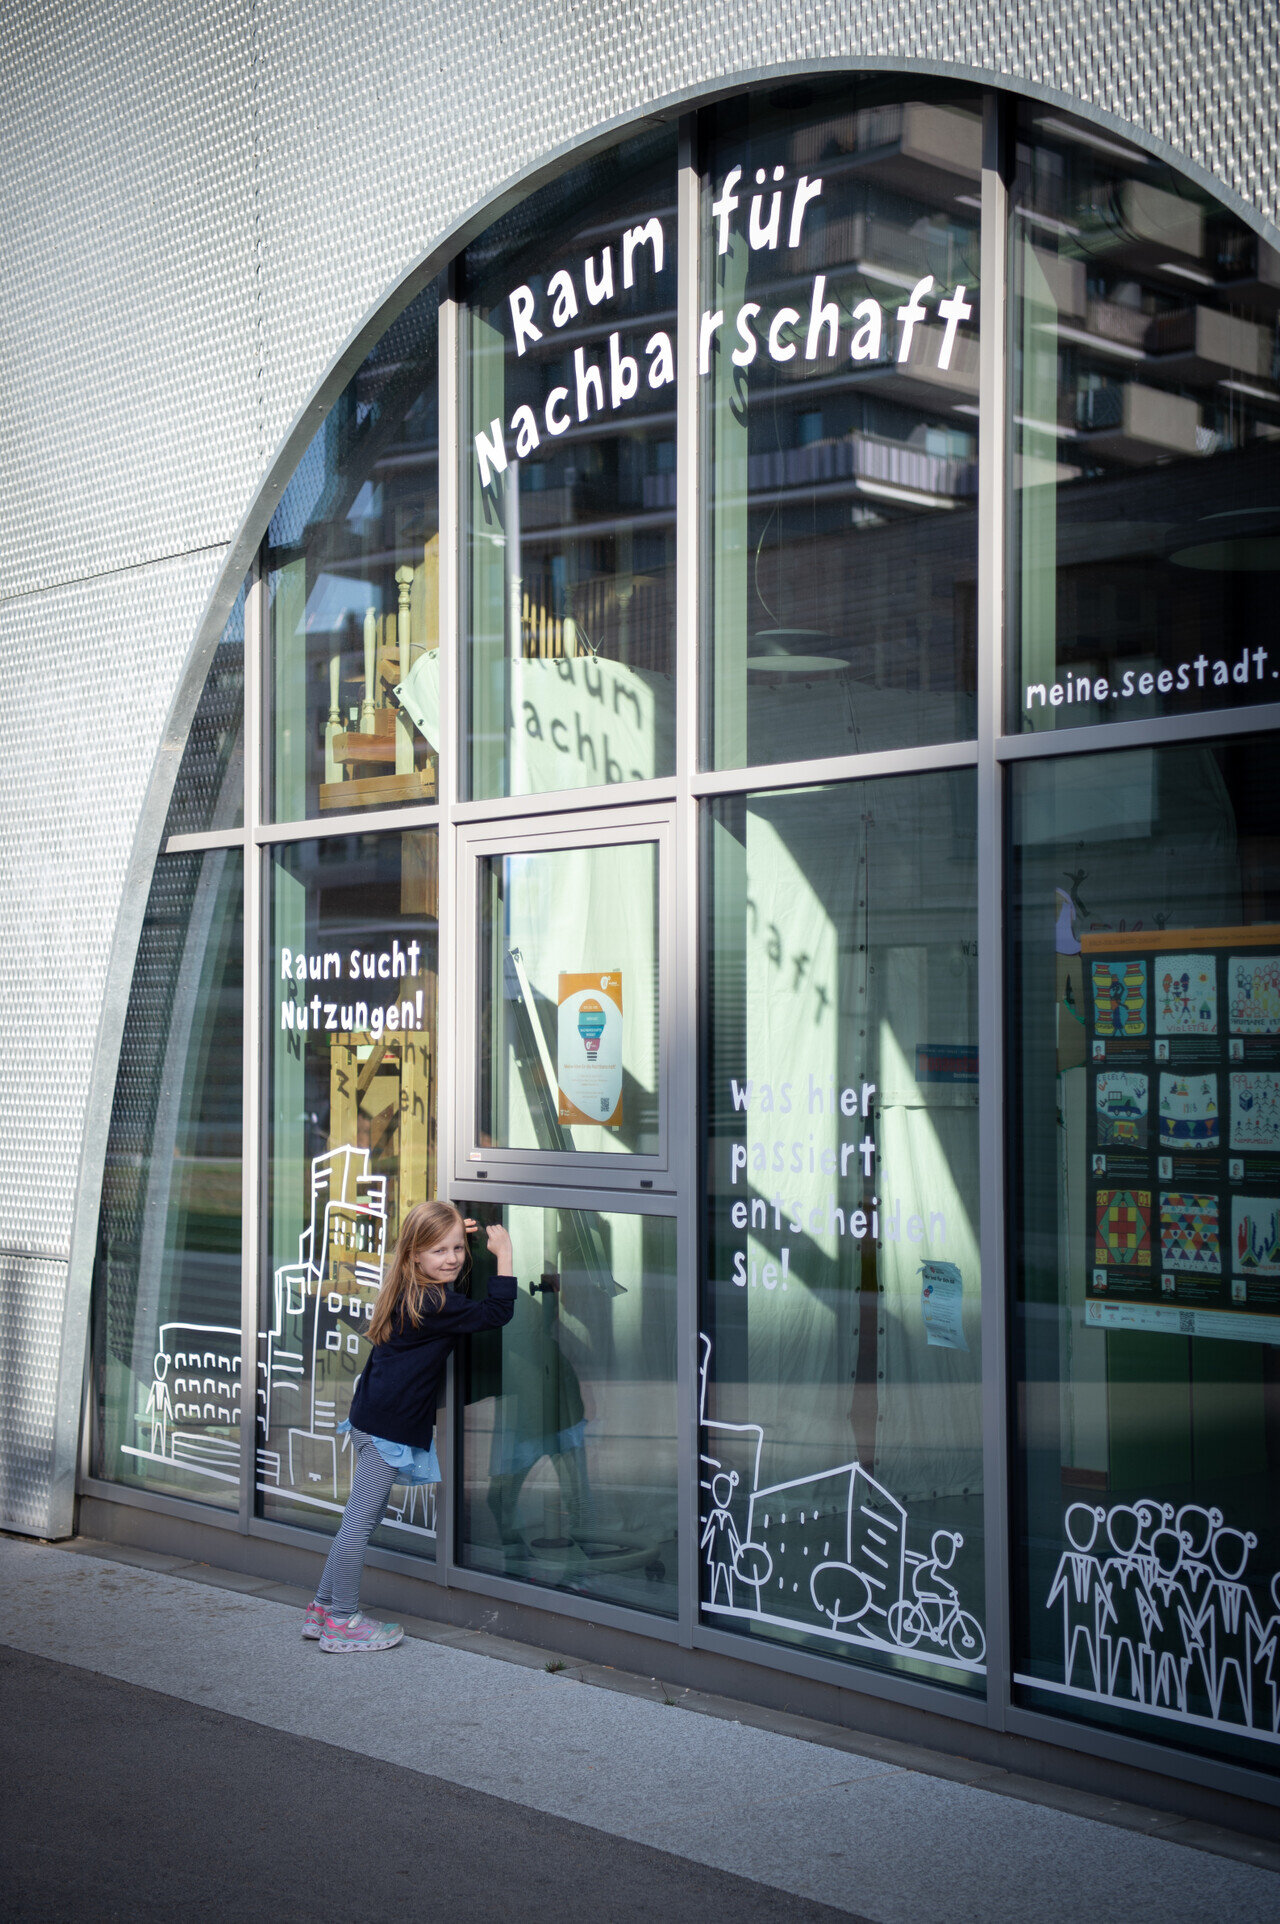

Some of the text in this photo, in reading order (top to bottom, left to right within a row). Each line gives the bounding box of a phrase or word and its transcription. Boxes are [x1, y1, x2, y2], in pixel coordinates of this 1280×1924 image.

[508, 163, 823, 357] Raum für
[474, 275, 972, 489] Nachbarschaft
[281, 940, 421, 980] Raum sucht
[281, 990, 424, 1040] Nutzungen!
[731, 1073, 876, 1117] was hier
[731, 1192, 947, 1244] entscheiden
[731, 1247, 790, 1292] Sie!
